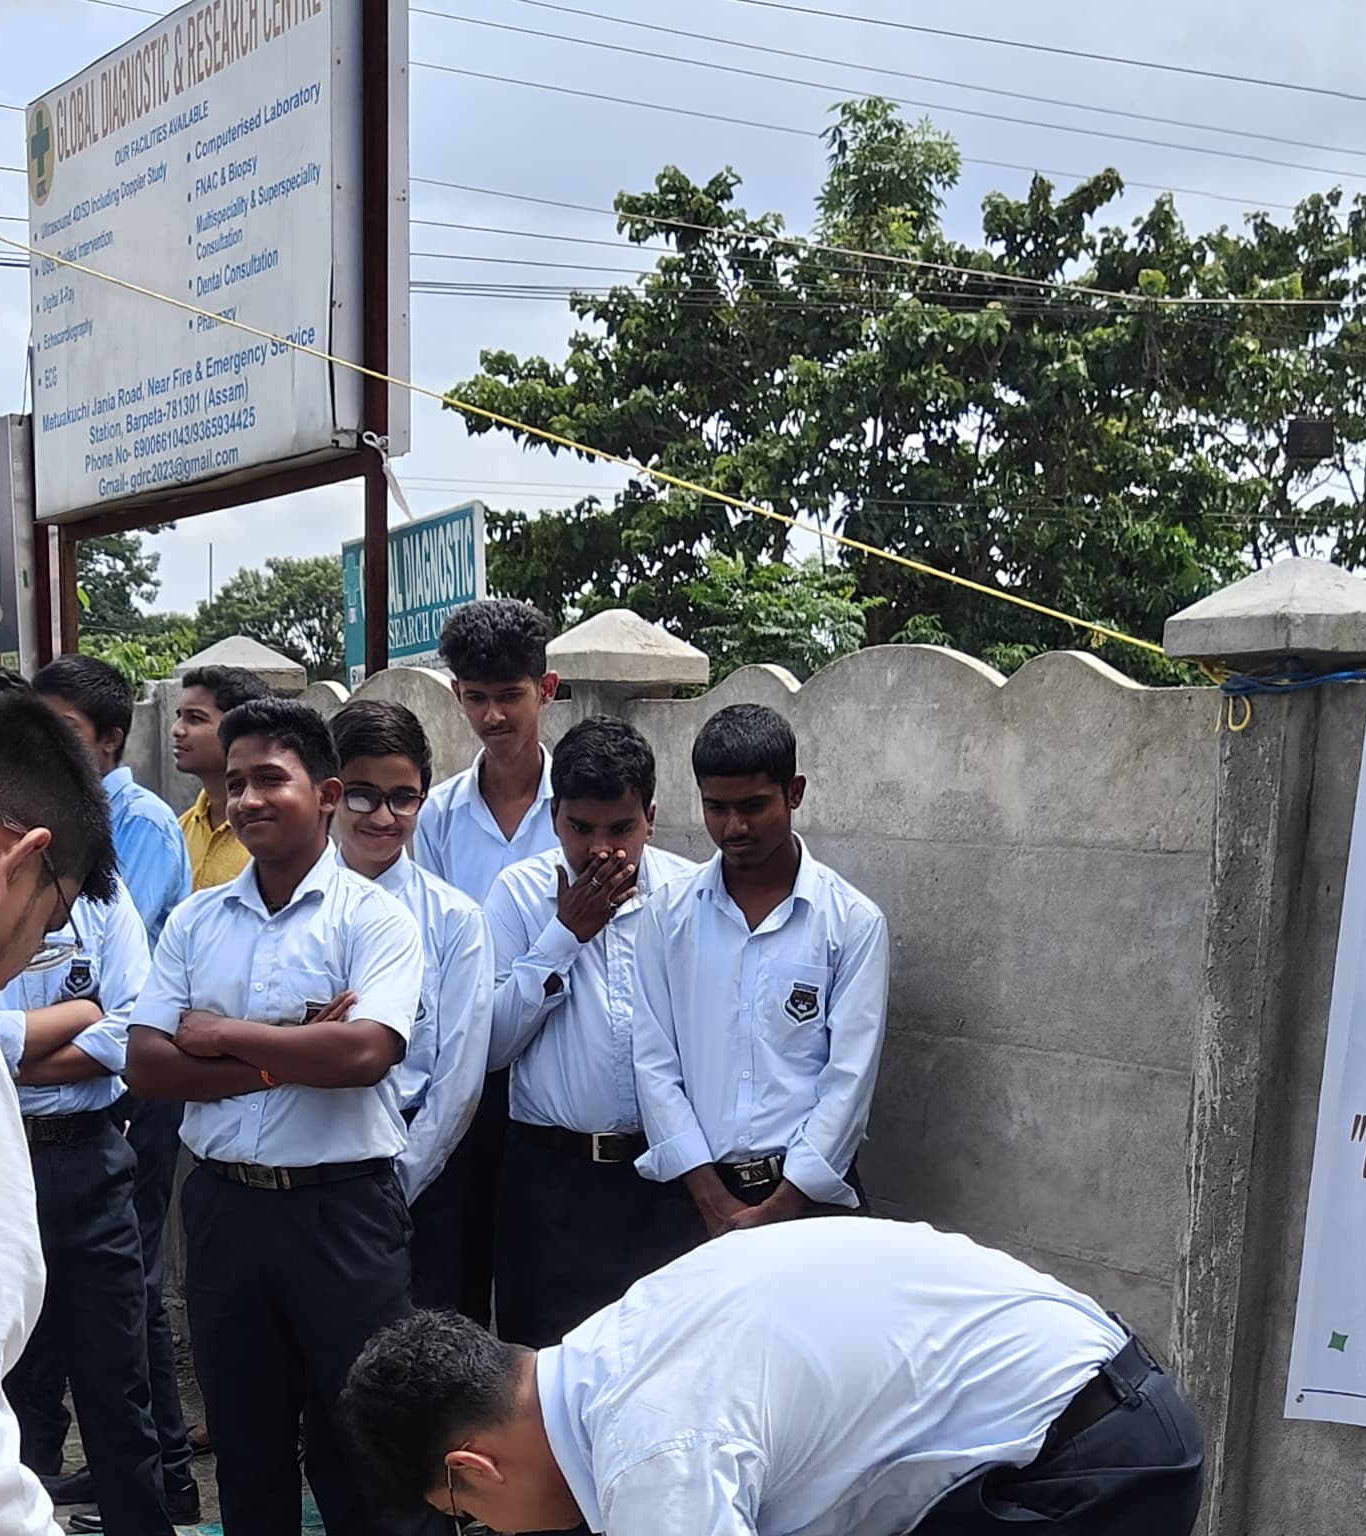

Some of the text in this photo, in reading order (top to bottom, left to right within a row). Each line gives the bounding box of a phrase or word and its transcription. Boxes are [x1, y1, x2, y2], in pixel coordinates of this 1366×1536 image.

[56, 79, 98, 162] GLOBAL
[101, 33, 169, 138] DIAGNOSTIC
[173, 24, 184, 95] &
[188, 0, 258, 88] RESEARCH
[114, 100, 209, 167] OUR FACILITIES AVAILABLE
[194, 82, 321, 160] Computerised Laboratory
[120, 172, 146, 199] Doppler
[147, 161, 168, 185] Study
[195, 156, 258, 198] FNAC & Biopsy
[196, 162, 322, 234] Multispeciality & Superspeciality
[196, 227, 243, 260] Consultation
[196, 248, 279, 296] Dental Consultation
[42, 400, 90, 432] Metuakuchi
[92, 392, 116, 417] Jania
[118, 381, 145, 408] Road,
[147, 376, 171, 399] Near
[172, 367, 192, 390] Fire
[195, 360, 203, 382] &
[206, 342, 268, 378] Emergency
[44, 366, 58, 389] ECG
[89, 376, 249, 445] Station, Barpeta-781301 (Assam)
[85, 451, 114, 475] Phone
[98, 446, 239, 496] Gmail- gdrc2023@gmail.com
[402, 515, 474, 611] DIAGNOSTIC
[388, 610, 430, 650] SEARCH
